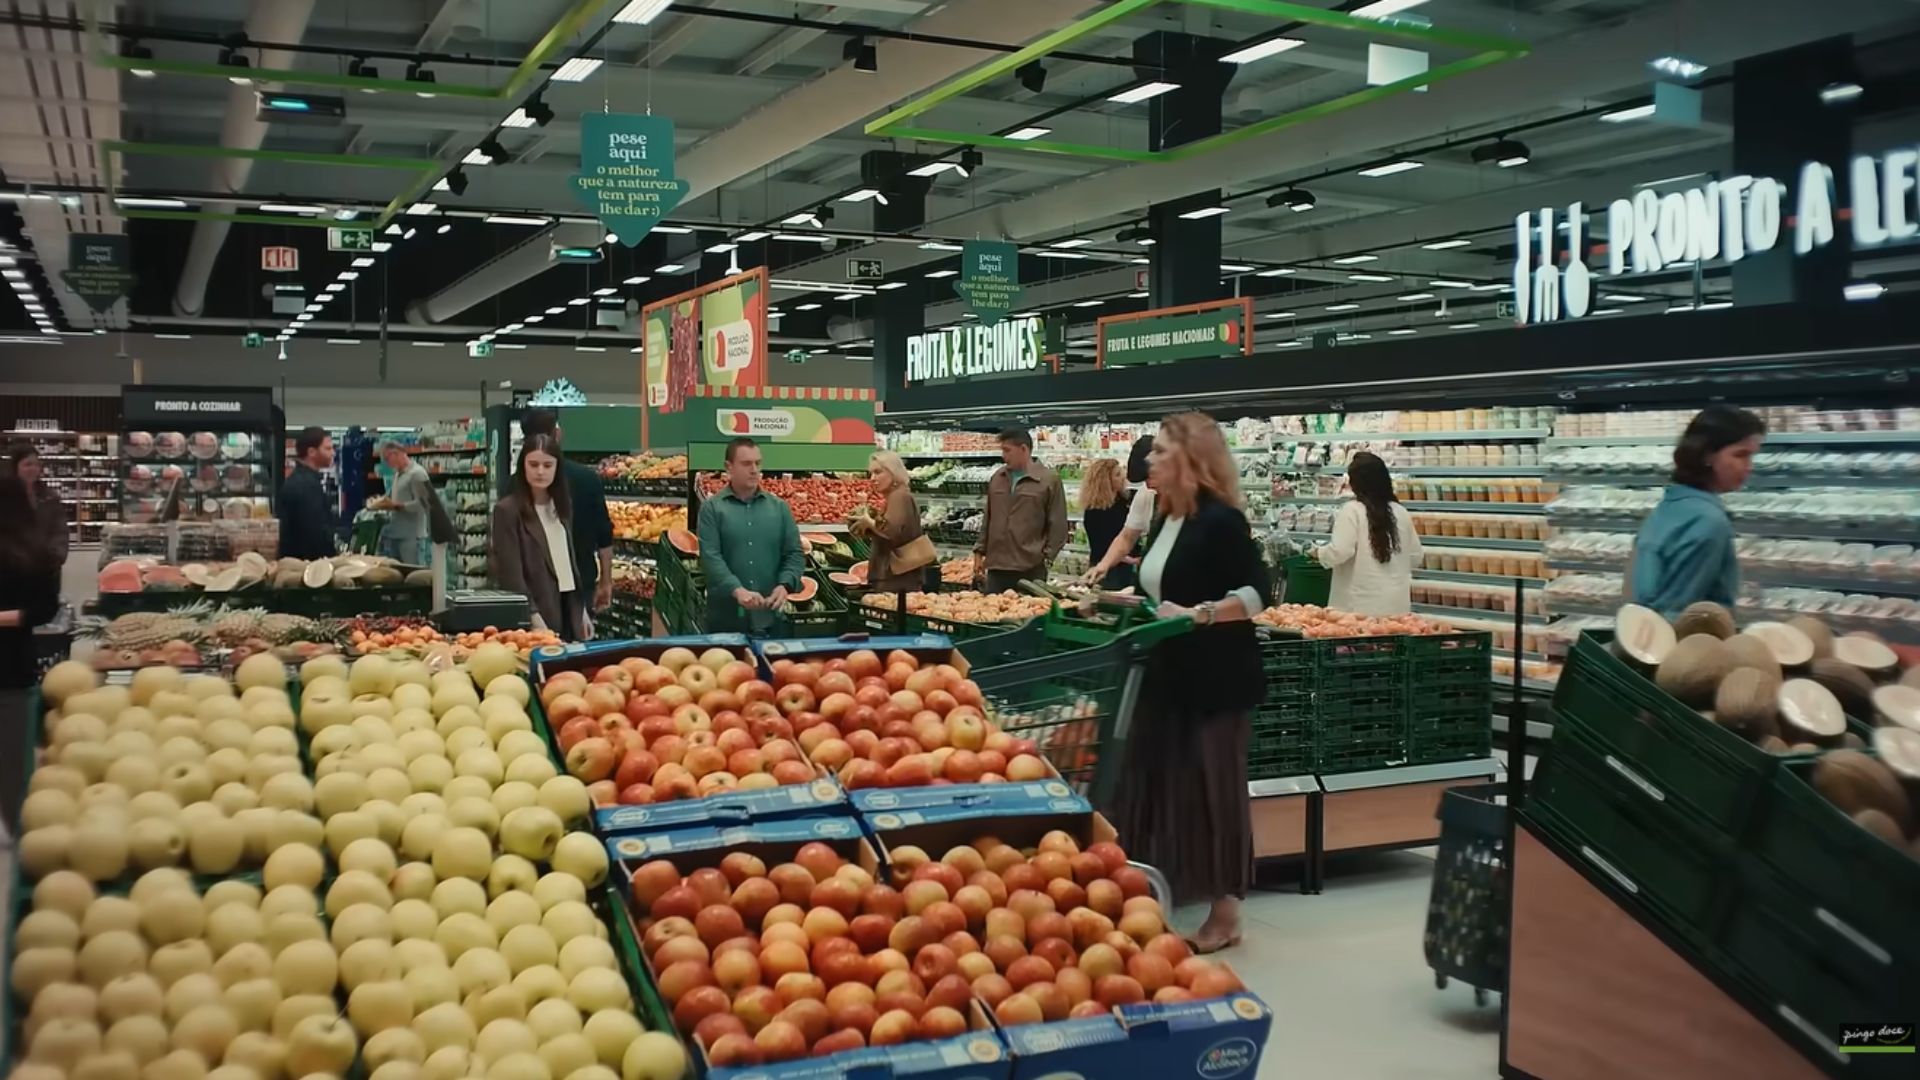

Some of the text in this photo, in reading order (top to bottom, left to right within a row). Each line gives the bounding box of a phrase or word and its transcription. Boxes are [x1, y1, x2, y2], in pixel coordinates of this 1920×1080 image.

[609, 133, 647, 147] pese
[609, 146, 647, 162] aqui
[597, 165, 660, 177] o melhor
[578, 178, 678, 191] que a natureza
[598, 190, 660, 203] tem para
[600, 203, 622, 214] lhe
[624, 203, 650, 216] dar
[1609, 148, 1920, 275] PRONTO A LE
[979, 254, 1002, 264] pese
[979, 261, 1002, 273] aqui
[979, 274, 1009, 283] melhor
[960, 283, 975, 291] que
[984, 284, 1020, 292] natureza
[972, 299, 985, 307] lhe
[990, 293, 1009, 301] para
[1107, 326, 1216, 353] FRUTA E LEGUMES NACIONAIS
[907, 317, 1038, 381] FRUTA & LEGUMES
[155, 401, 241, 412] PRONTO A COZINHAR
